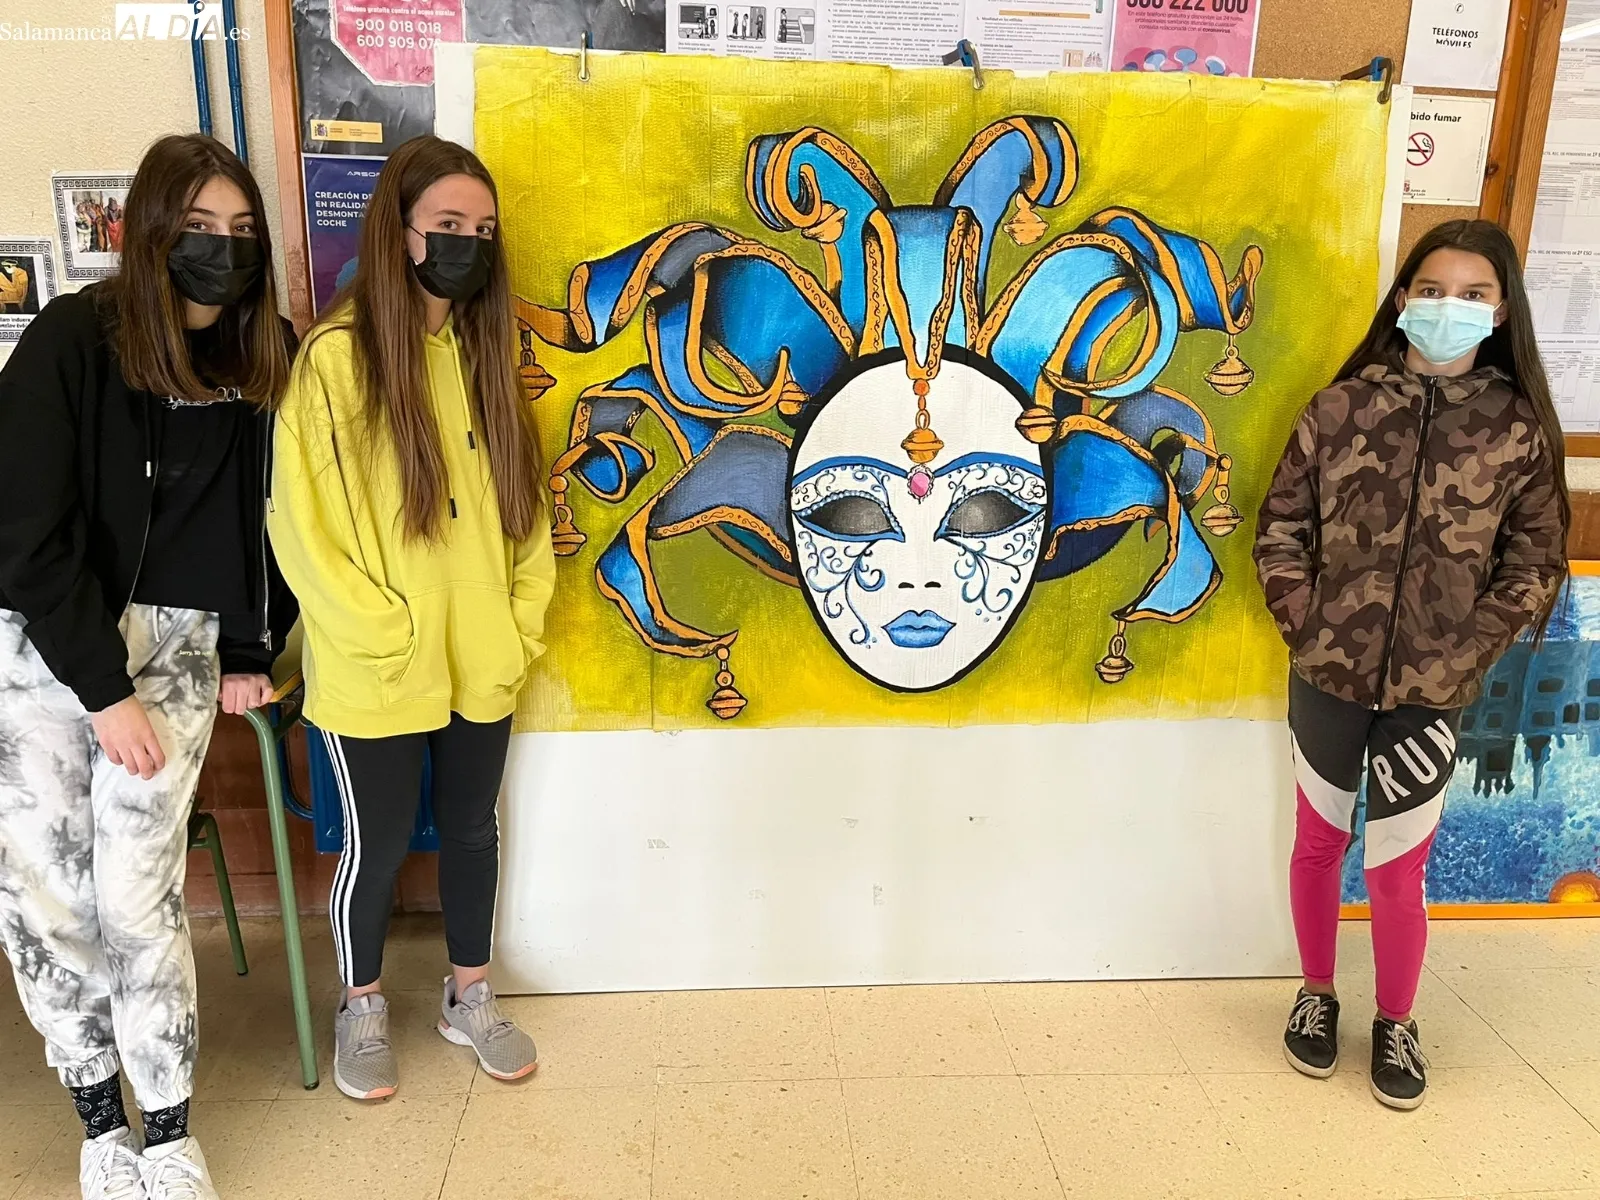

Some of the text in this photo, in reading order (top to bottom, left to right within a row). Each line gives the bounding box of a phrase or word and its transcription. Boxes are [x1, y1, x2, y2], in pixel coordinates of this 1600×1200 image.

[356, 19, 441, 34] 900 018 018
[1432, 27, 1479, 39] TELÉFONOS
[357, 35, 384, 47] 600
[388, 36, 414, 48] 909
[1410, 112, 1462, 122] bido fumar
[315, 191, 359, 200] CREACIÓN
[330, 201, 369, 209] REALIDA
[317, 219, 347, 227] COCHE
[1372, 718, 1456, 804] RUN
